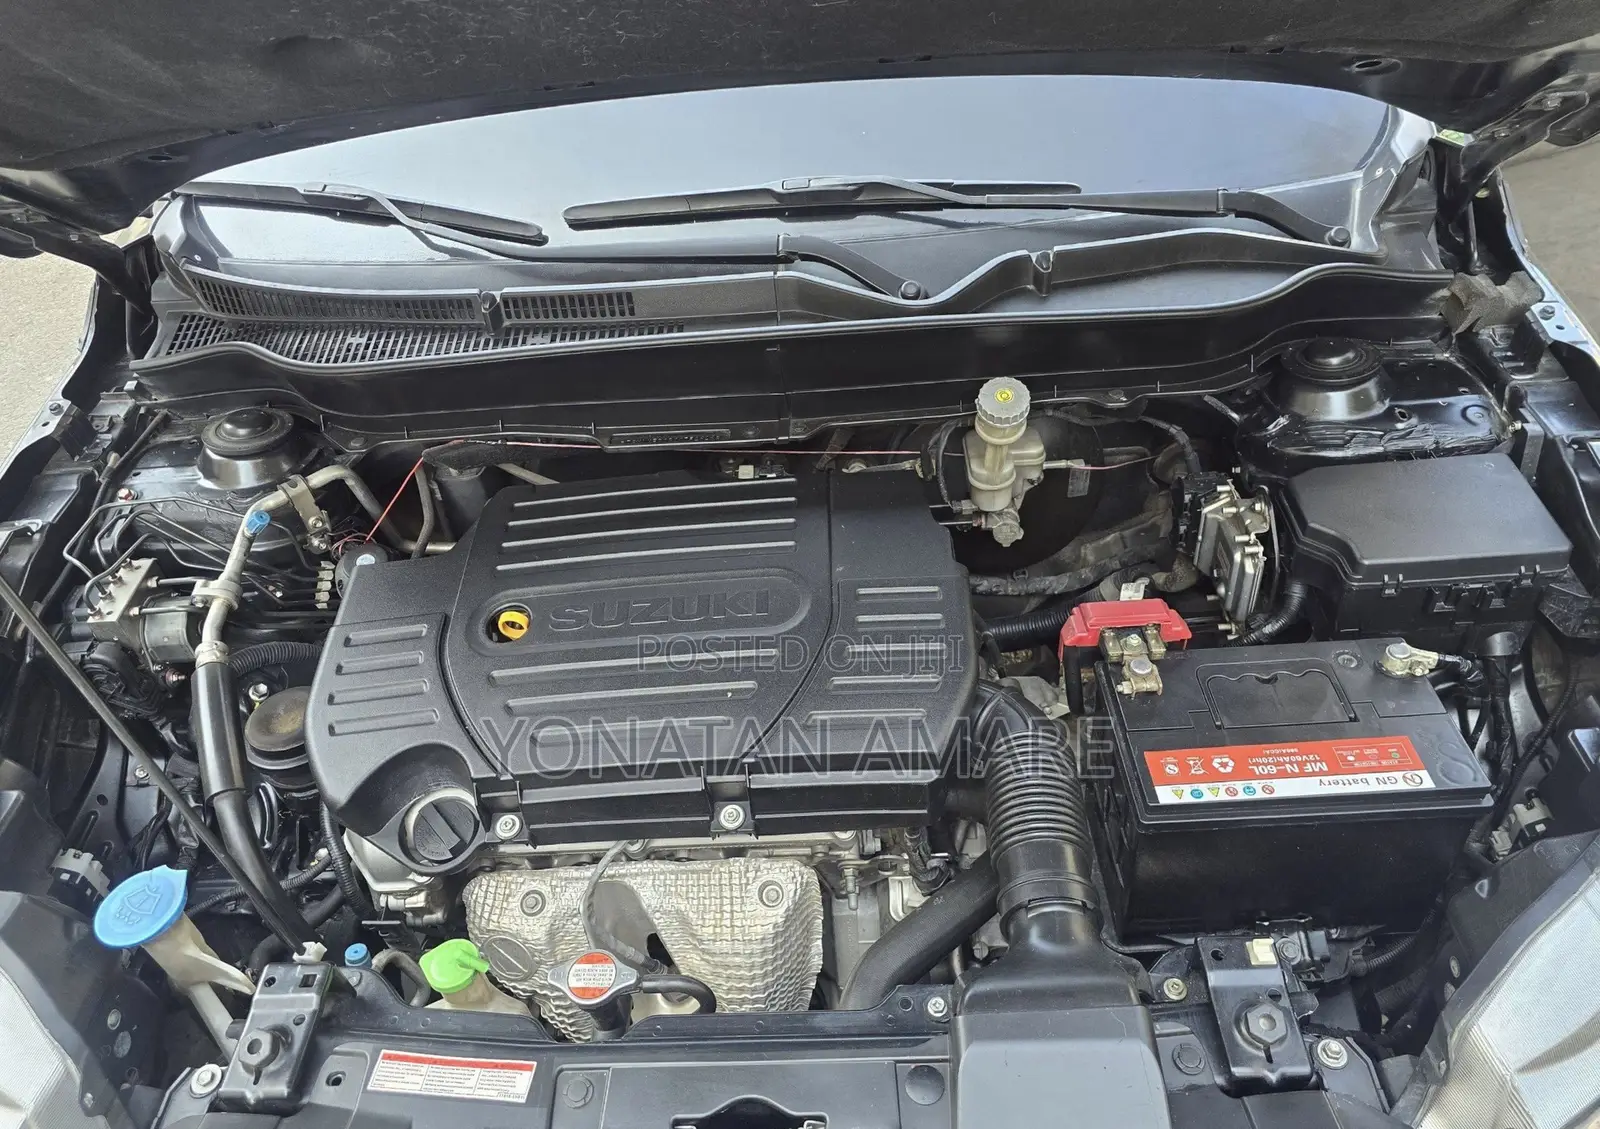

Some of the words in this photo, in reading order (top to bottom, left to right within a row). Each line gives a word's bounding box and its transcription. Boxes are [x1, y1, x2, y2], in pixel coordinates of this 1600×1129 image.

[549, 590, 769, 632] SUZUKI
[1304, 761, 1329, 773] MF
[1318, 777, 1369, 787] battery
[1377, 775, 1398, 786] GN
